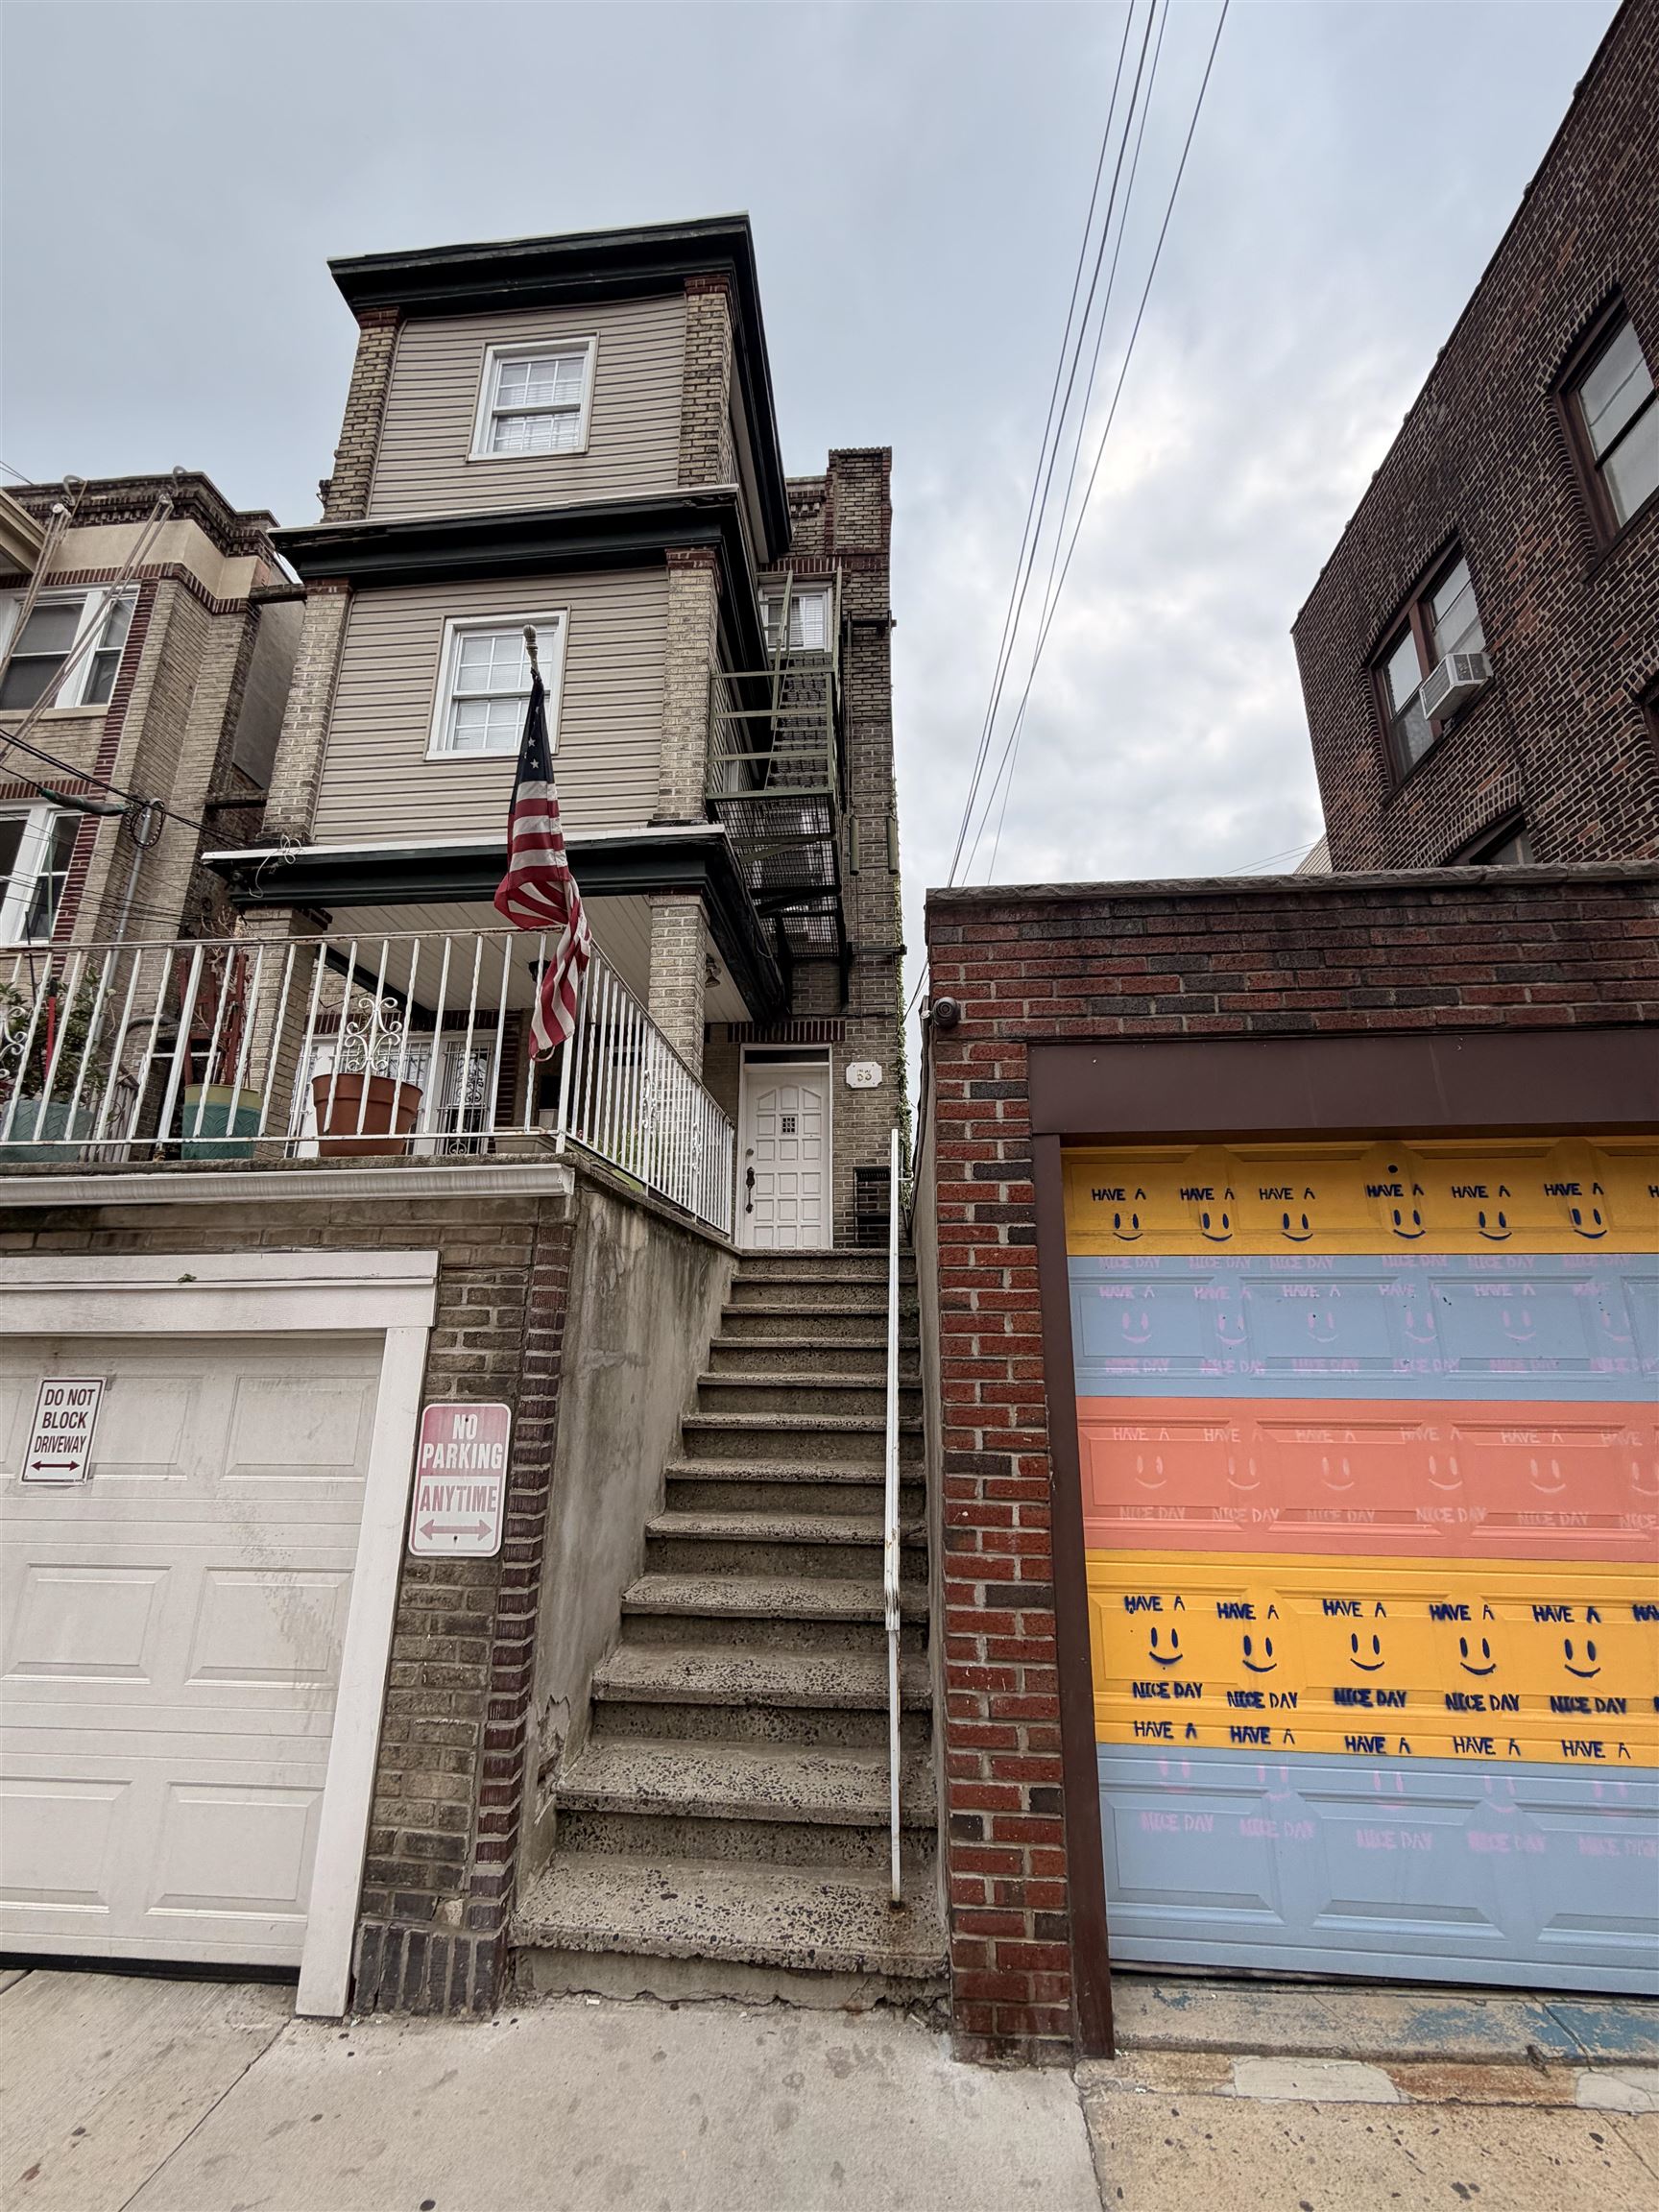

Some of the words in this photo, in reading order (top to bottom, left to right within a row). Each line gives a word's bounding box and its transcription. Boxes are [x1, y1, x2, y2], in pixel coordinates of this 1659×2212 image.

[1092, 1188, 1125, 1201] HAVE
[1135, 1188, 1146, 1200] A
[1180, 1188, 1214, 1201] HAVE
[1224, 1188, 1235, 1200] A
[1259, 1188, 1293, 1201] HAVE
[1304, 1188, 1315, 1200] A
[1366, 1184, 1404, 1197] HAVE
[1412, 1184, 1425, 1196] A
[1452, 1185, 1488, 1199] HAVE
[1499, 1185, 1511, 1198] A
[1544, 1183, 1582, 1196] HAVE
[1593, 1183, 1604, 1195] A
[1329, 1285, 1341, 1298] A
[44, 1388, 64, 1406] DO
[66, 1388, 95, 1406] NOT
[41, 1411, 88, 1429] BLOCK
[452, 1414, 477, 1440] NO
[1114, 1428, 1149, 1440] HAVE
[1159, 1428, 1170, 1440] A
[1203, 1429, 1241, 1442] HAVE
[1296, 1429, 1334, 1442] HAVE
[1345, 1430, 1357, 1442] A
[1400, 1428, 1439, 1441] HAVE
[1501, 1431, 1540, 1444] HAVE
[1551, 1430, 1565, 1443] A
[34, 1435, 87, 1454] DRIVEWAY
[421, 1443, 503, 1469] PARKING
[420, 1485, 497, 1512] ANYTIME
[1119, 1506, 1154, 1521] NICE
[1158, 1506, 1186, 1520] DAY
[1213, 1507, 1248, 1523] NICE
[1252, 1508, 1280, 1523] DAY
[1307, 1508, 1340, 1523] NICE
[1346, 1508, 1376, 1523] DAY
[1416, 1507, 1455, 1523] NICE
[1457, 1507, 1487, 1522] DAY
[1559, 1512, 1588, 1527] DAY
[1124, 1596, 1164, 1612] HAVE
[1174, 1596, 1186, 1611] A
[1216, 1601, 1256, 1620] HAVE
[1267, 1604, 1279, 1620] A
[1323, 1599, 1363, 1617] HAVE
[1375, 1601, 1386, 1618] A
[1430, 1604, 1472, 1621] HAVE
[1482, 1604, 1495, 1620] A
[1532, 1605, 1575, 1623] HAVE
[1586, 1606, 1601, 1623] A
[1133, 1682, 1170, 1699] NICE
[1173, 1682, 1203, 1699] DAY
[1334, 1688, 1374, 1707] NICE
[1376, 1690, 1407, 1708] DAY
[1227, 1691, 1265, 1709] NICE
[1269, 1692, 1298, 1709] DAY
[1445, 1693, 1486, 1712] NICE
[1490, 1694, 1520, 1712] DAY
[1551, 1695, 1592, 1714] NICE
[1595, 1697, 1627, 1715] DAY
[1134, 1720, 1174, 1739] HAVE
[1185, 1722, 1197, 1740] A
[1230, 1725, 1271, 1744] HAVE
[1283, 1728, 1295, 1744] A
[1344, 1735, 1387, 1755] HAVE
[1399, 1737, 1411, 1754] A
[1453, 1736, 1496, 1755] HAVE
[1508, 1738, 1521, 1756] A
[1561, 1739, 1606, 1759] HAVE
[1619, 1743, 1631, 1759] A
